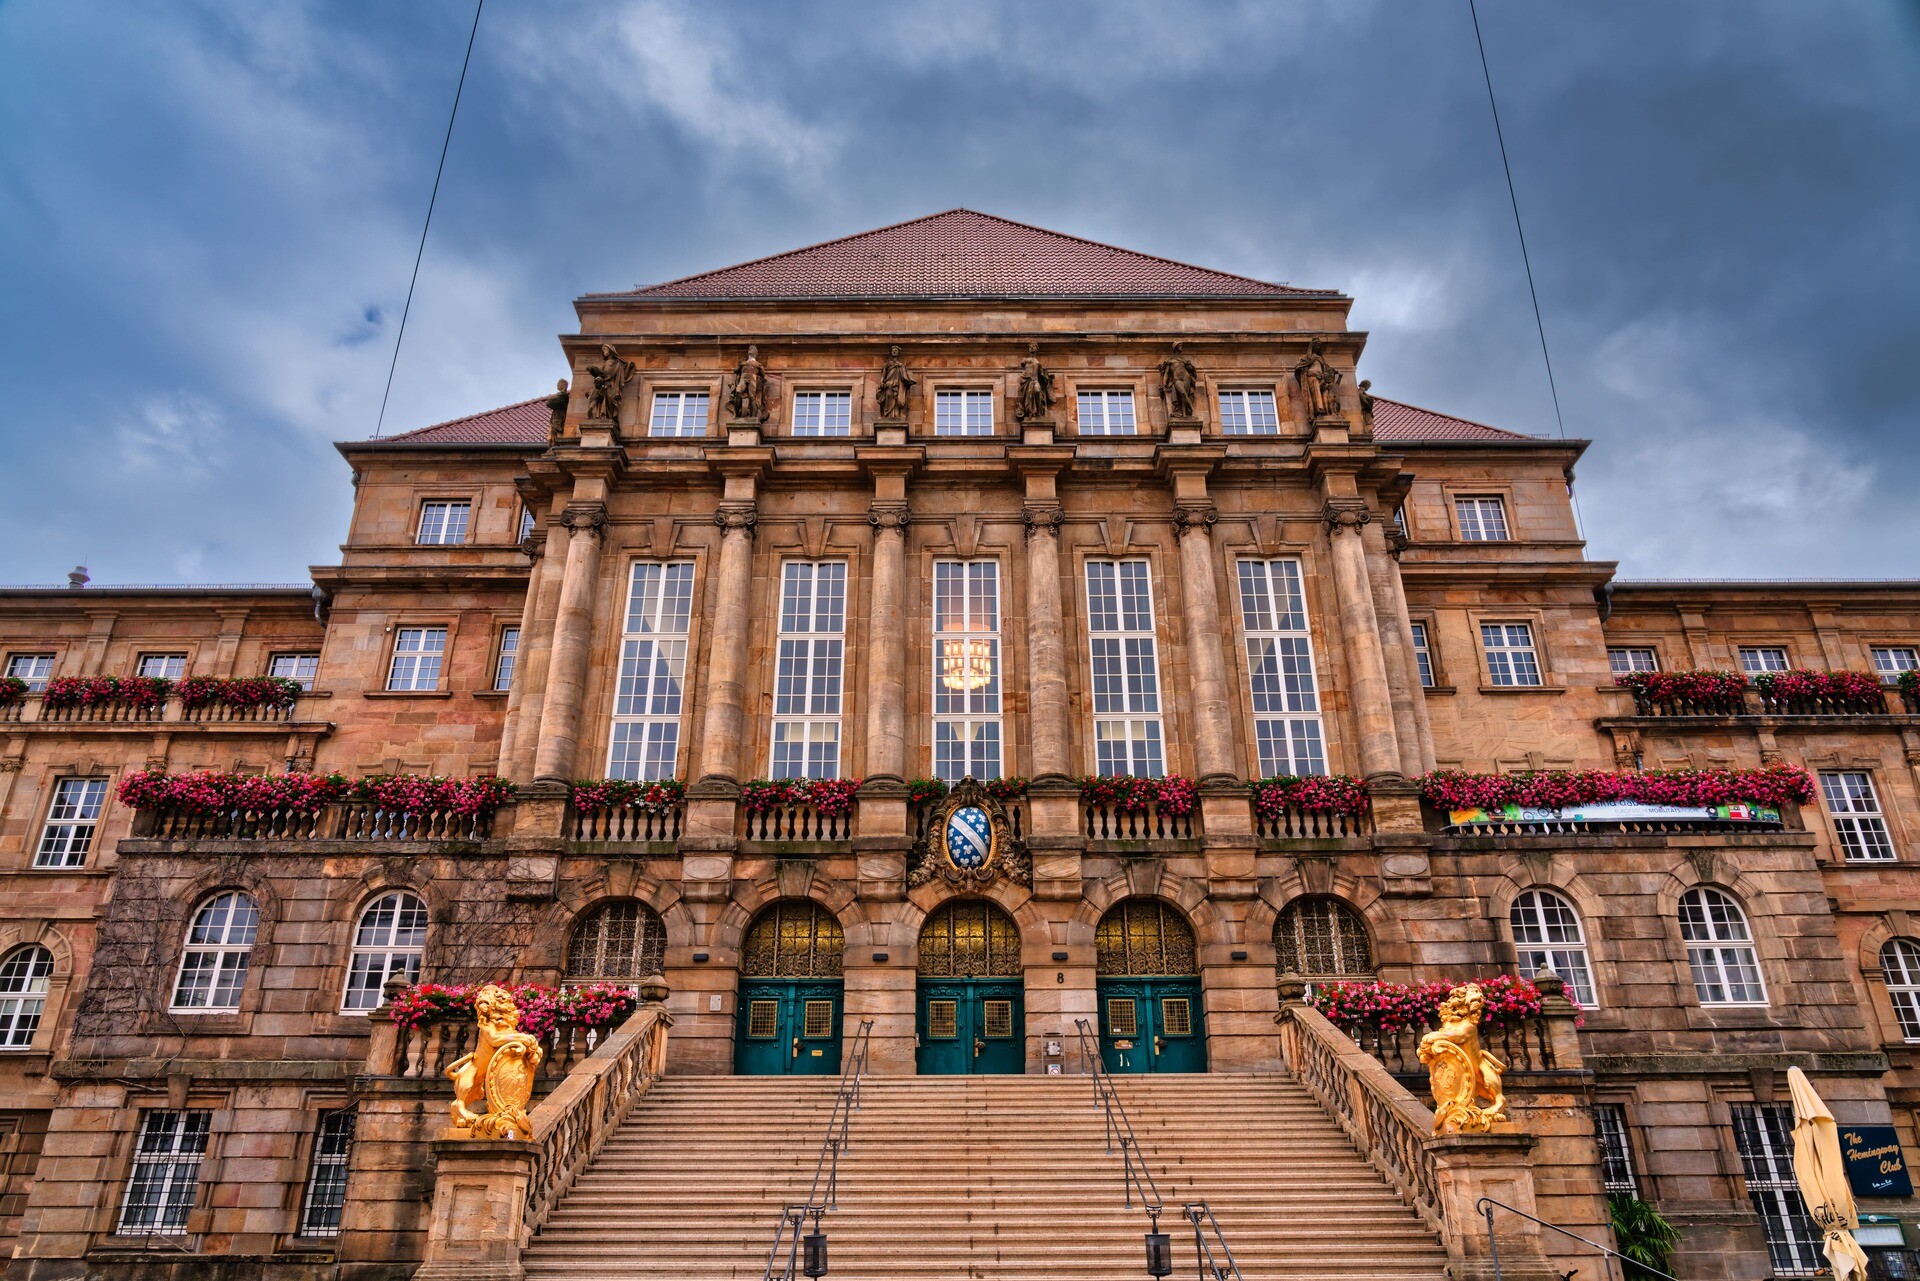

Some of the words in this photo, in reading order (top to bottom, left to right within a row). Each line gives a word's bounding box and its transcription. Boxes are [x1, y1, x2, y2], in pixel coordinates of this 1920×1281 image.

[1057, 972, 1064, 983] 8
[1844, 1132, 1863, 1146] The
[1847, 1145, 1899, 1161] Hemingway
[1880, 1157, 1902, 1174] Club
